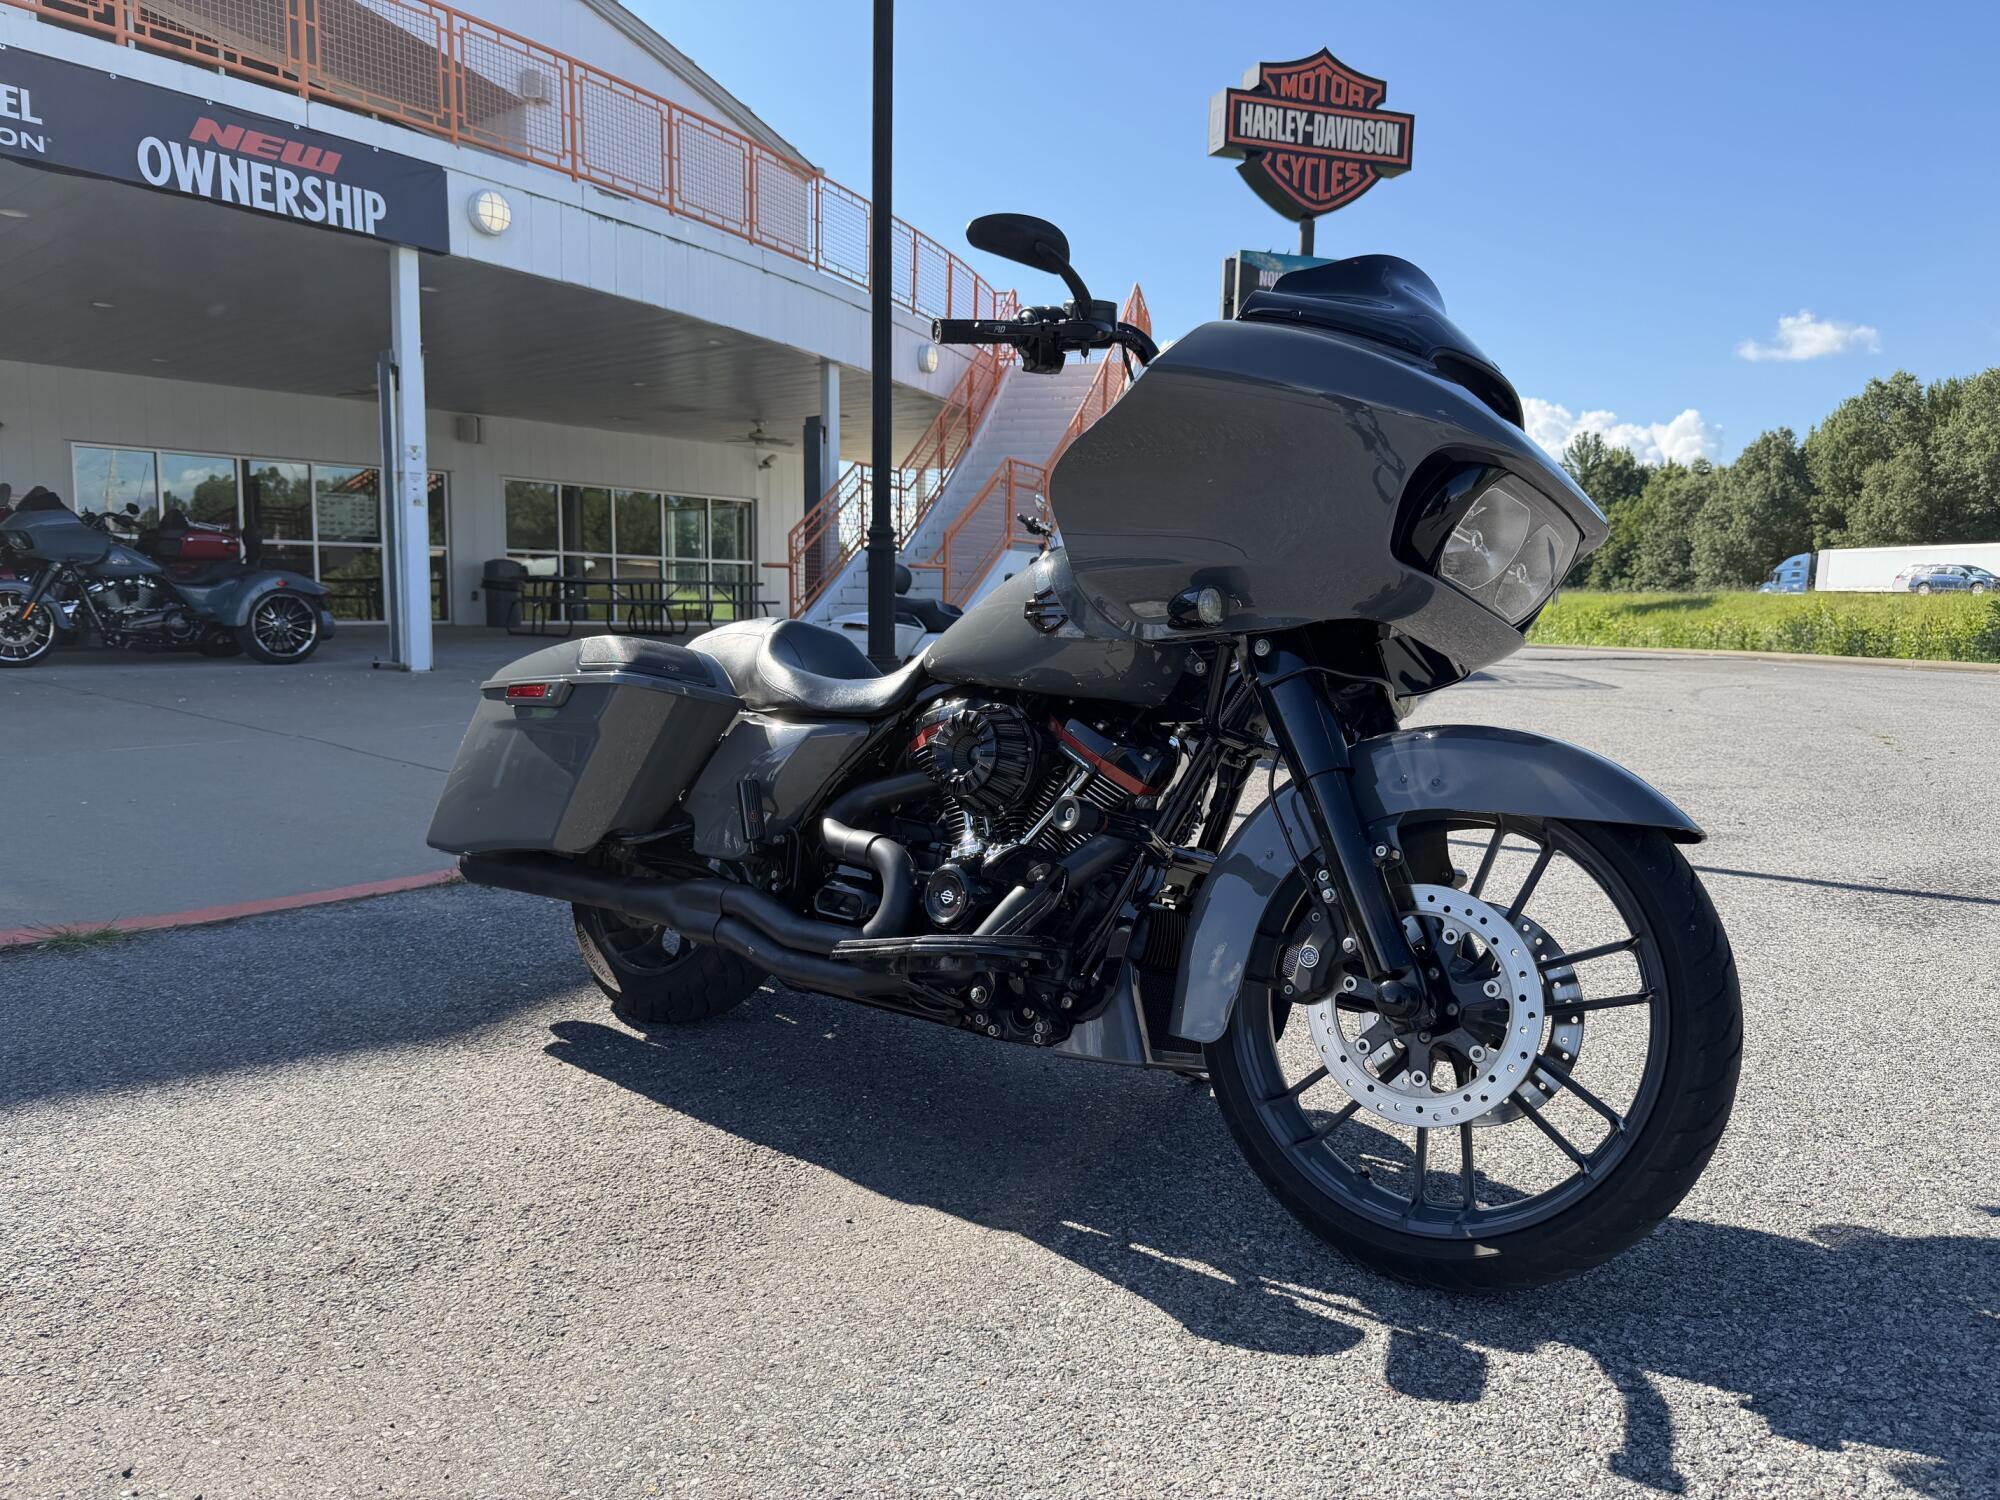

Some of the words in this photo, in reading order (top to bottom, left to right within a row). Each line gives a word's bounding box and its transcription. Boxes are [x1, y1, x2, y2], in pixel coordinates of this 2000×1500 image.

[1280, 65, 1364, 109] MOTOR
[189, 117, 343, 174] NEW
[1239, 102, 1400, 156] HARLEY-DAVIDSON
[137, 136, 387, 235] OWNERSHIP
[1276, 153, 1361, 201] CYCLES
